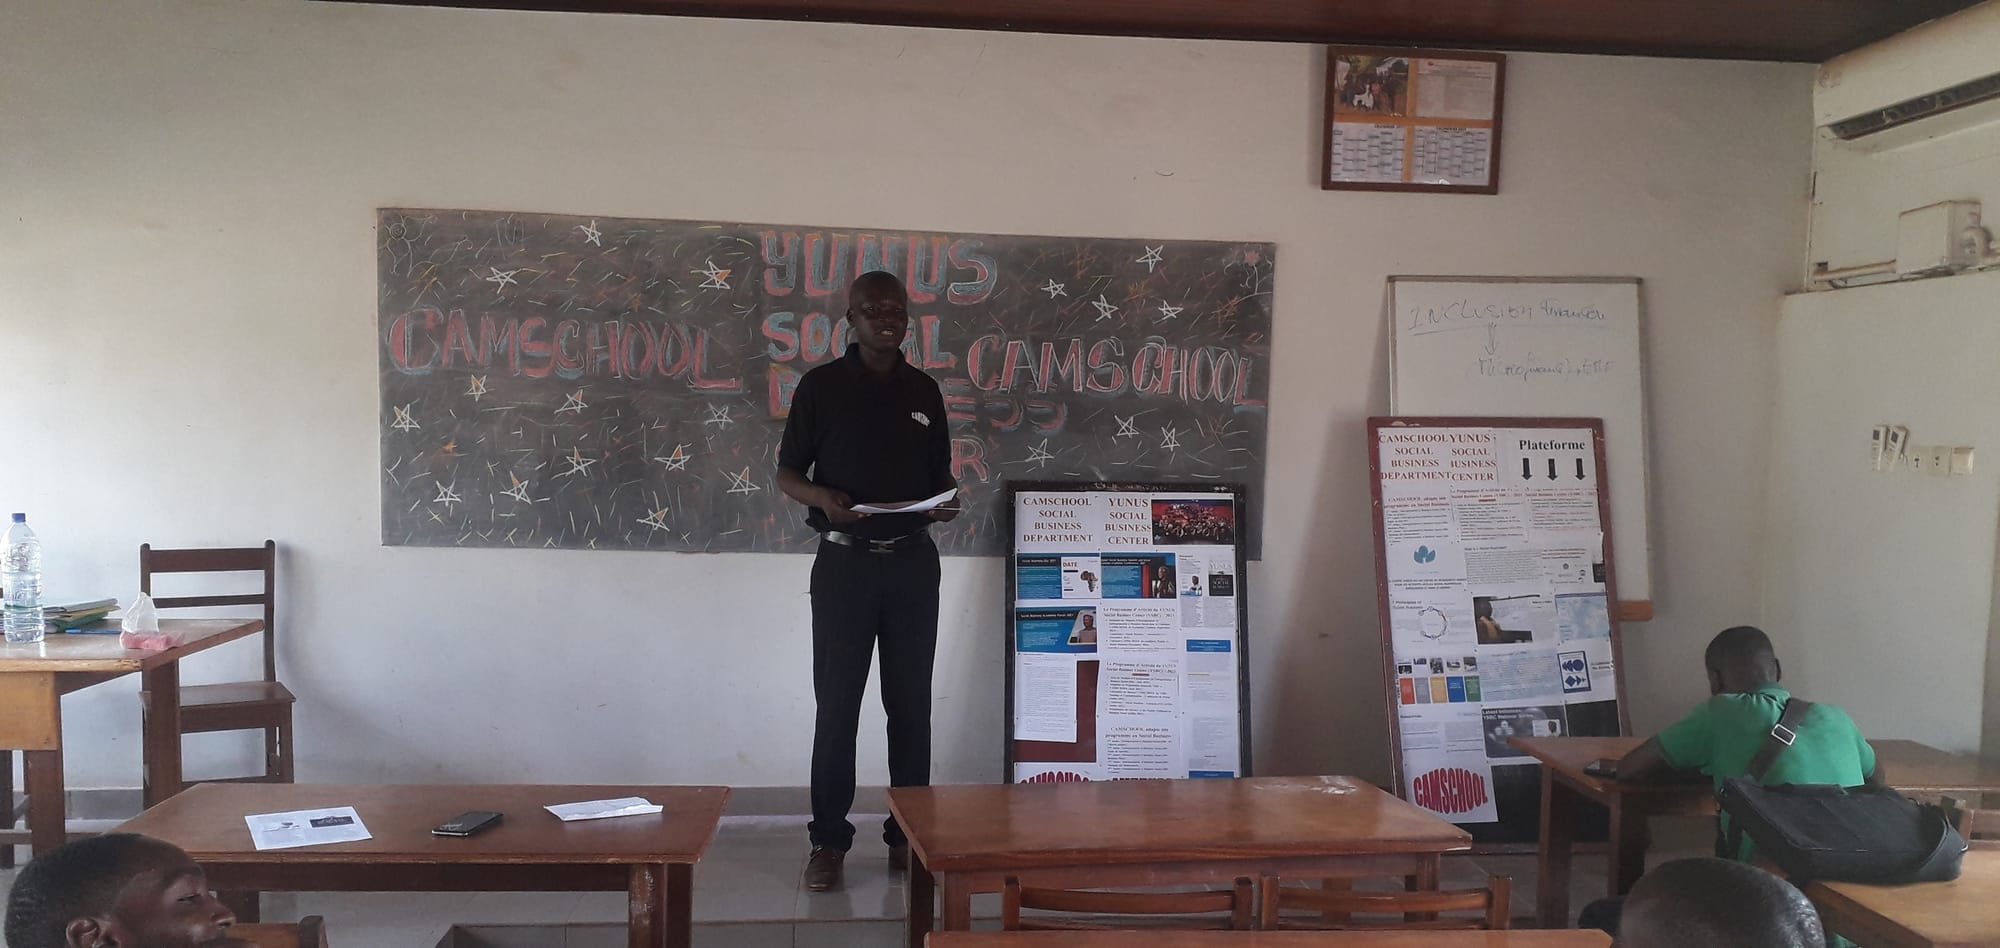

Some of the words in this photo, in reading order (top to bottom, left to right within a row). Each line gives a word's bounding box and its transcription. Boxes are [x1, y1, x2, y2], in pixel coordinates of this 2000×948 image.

[761, 231, 997, 304] YUNUS
[762, 312, 956, 369] SOCAL
[388, 305, 743, 393] CAMSCHOOL
[1379, 433, 1449, 443] CAMSCHOOL
[1449, 433, 1491, 443] YUNUS
[1519, 439, 1585, 450] Plateforme
[1394, 447, 1434, 455] SOCIAL
[1451, 447, 1489, 456] SOCIAL
[1391, 459, 1440, 468] BUSINESS
[1381, 471, 1452, 480] DEPARTMENT
[1451, 472, 1494, 481] CENTER
[1023, 497, 1092, 506] CAMSCHOOL
[1108, 498, 1149, 507] YUNUS
[1038, 510, 1077, 518] SOCIAL
[1109, 511, 1148, 520] SOCIAL
[1034, 522, 1082, 530] BUSINESS
[1105, 523, 1152, 532] BUSINESS
[1023, 534, 1093, 542] DEPARTMENT
[1107, 536, 1150, 545] CENTER
[1413, 767, 1488, 815] CAMSCHOOL
